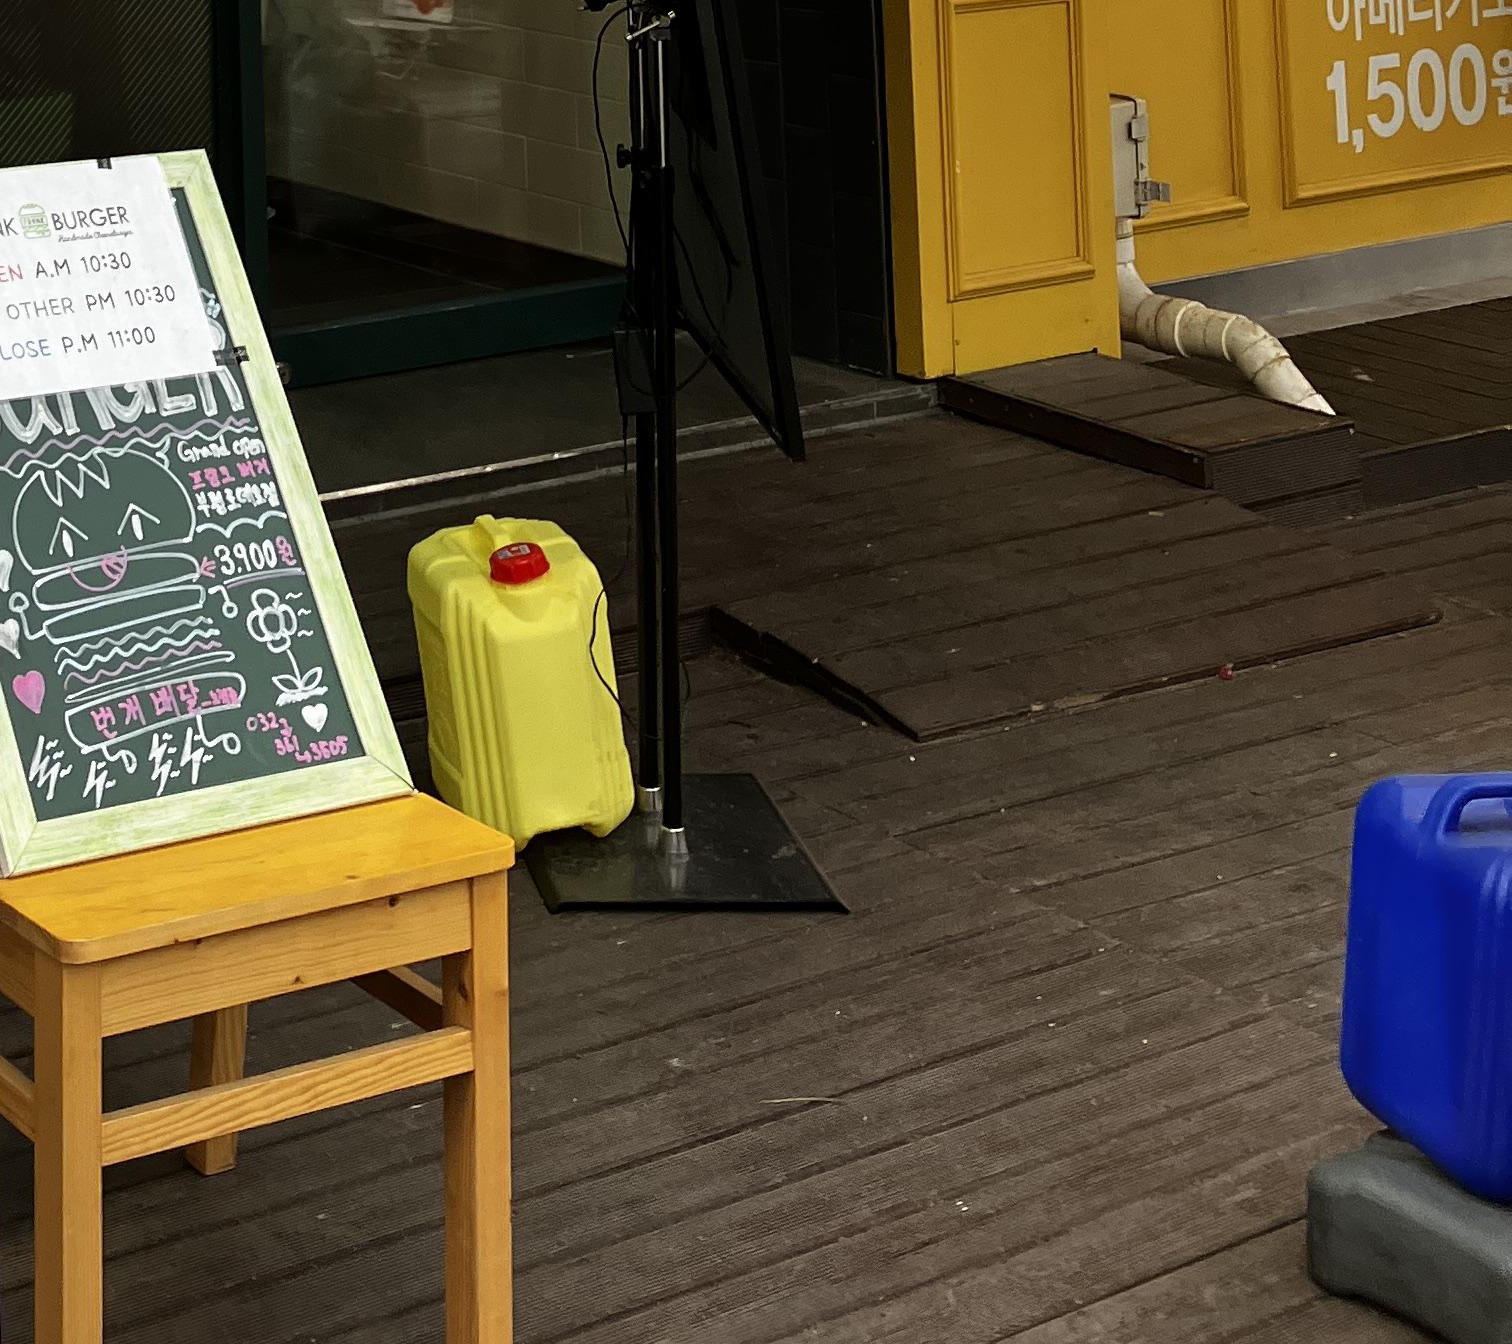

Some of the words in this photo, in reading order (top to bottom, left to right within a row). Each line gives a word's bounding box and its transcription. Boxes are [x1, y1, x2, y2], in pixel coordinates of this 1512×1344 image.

[1326, 43, 1512, 153] 1,500원
[52, 207, 130, 230] BURGER
[36, 259, 71, 278] A.M
[80, 252, 131, 273] 10:30
[6, 298, 75, 320] OTHER
[86, 292, 116, 312] PM
[125, 284, 176, 307] 10:30
[62, 333, 98, 354] P.M
[107, 326, 156, 348] 11:00
